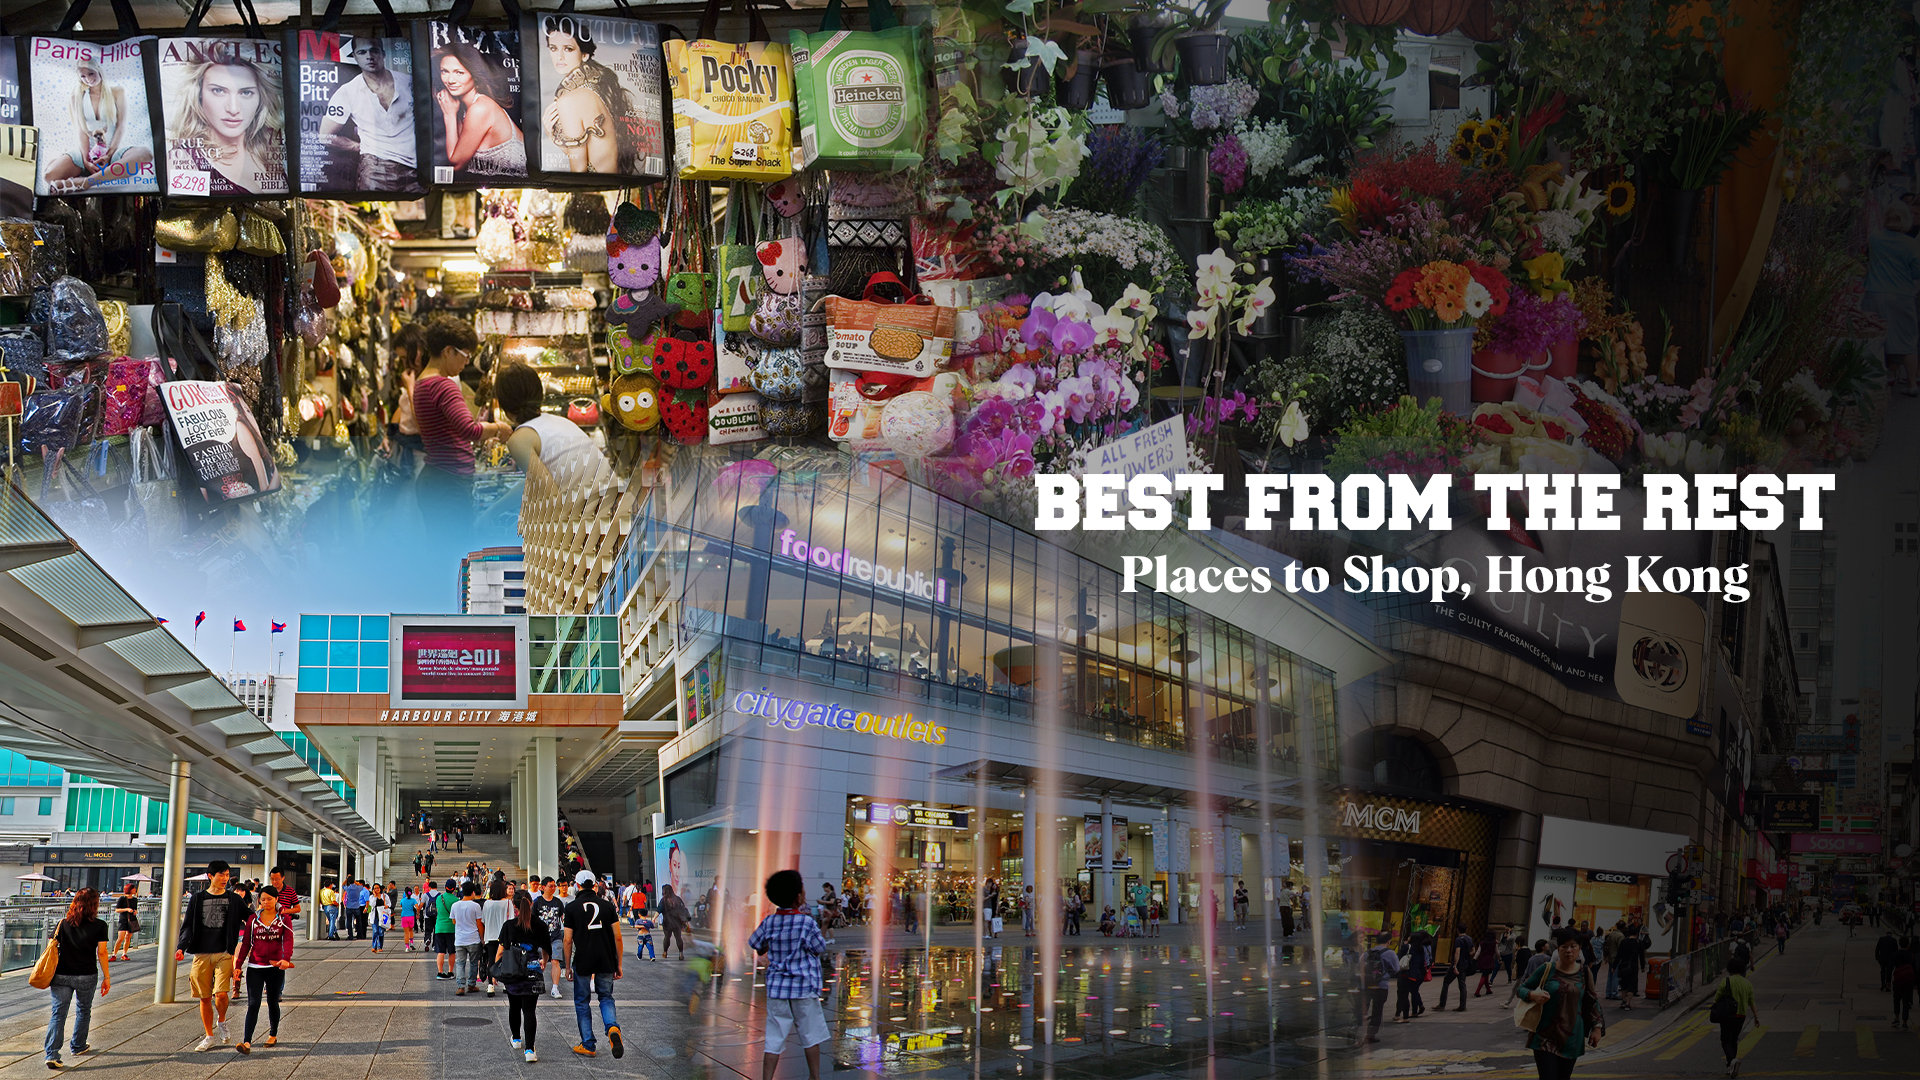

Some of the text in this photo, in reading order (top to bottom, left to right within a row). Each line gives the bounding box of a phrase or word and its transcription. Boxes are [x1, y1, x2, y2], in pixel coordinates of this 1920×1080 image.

[541, 15, 659, 47] COUTURE
[35, 38, 92, 61] Paris
[300, 64, 339, 84] Brad
[701, 55, 777, 102] Pocky
[836, 58, 898, 82] HEINEKEN LAGER BEER
[300, 83, 330, 102] Pitt
[712, 95, 764, 103] CHOCO BANANA
[835, 87, 901, 104] Heineken
[300, 101, 344, 117] Moves
[301, 117, 319, 132] On
[627, 124, 661, 140] NOW!
[840, 110, 899, 137] PREMIUM QUALITY
[96, 161, 154, 176] YOUR
[709, 155, 726, 165] The
[756, 157, 782, 167] Snack
[88, 177, 130, 188] Special
[836, 341, 858, 349] SOUP
[177, 408, 227, 429] FABULOUS
[187, 418, 231, 436] LOOK YOUR
[184, 427, 228, 446] BEST EVER
[1101, 422, 1173, 467] ALL FRESH
[193, 442, 233, 461] FASHION
[199, 451, 234, 467] PREVIEW
[197, 463, 217, 477] THE
[1434, 603, 1455, 619] THE
[1458, 612, 1493, 632] GUILTY
[1494, 626, 1541, 657] FRAGRANCES
[1566, 665, 1586, 679] AND
[1588, 671, 1605, 684] HER
[459, 648, 500, 666] 2011
[380, 710, 491, 722] HARBOUR CITY
[497, 710, 538, 723] 海港城
[734, 686, 947, 745] citygateoutlets
[1342, 802, 1422, 835] MCM
[1594, 872, 1633, 884] GEOX
[583, 901, 603, 930] 2
